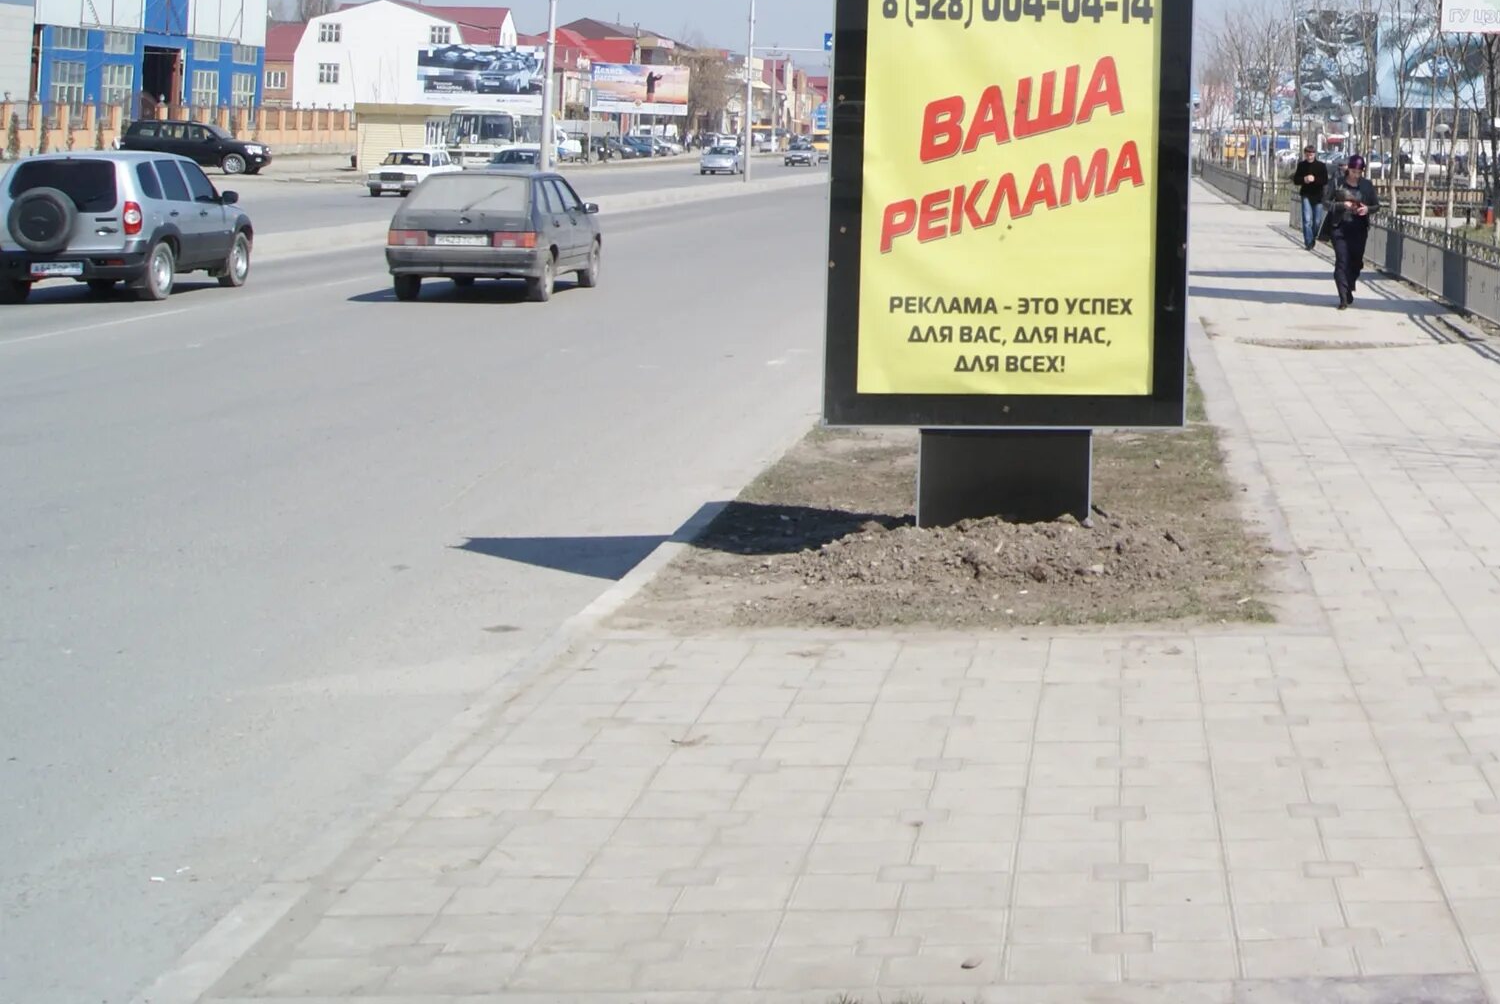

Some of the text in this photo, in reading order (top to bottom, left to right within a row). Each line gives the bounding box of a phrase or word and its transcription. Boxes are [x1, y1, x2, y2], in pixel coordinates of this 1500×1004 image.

[920, 55, 1124, 163] ВАША
[880, 140, 1145, 253] РЕКЛАМА
[889, 296, 998, 314] РЕКЛАМА
[1017, 297, 1059, 315] ЭТО
[1066, 297, 1133, 316] УСПЕХ
[907, 326, 1112, 347] ДЛЯ ВАС, ДЛЯ НАС,
[953, 355, 1066, 373] ДЛЯ ВСЕХ!
